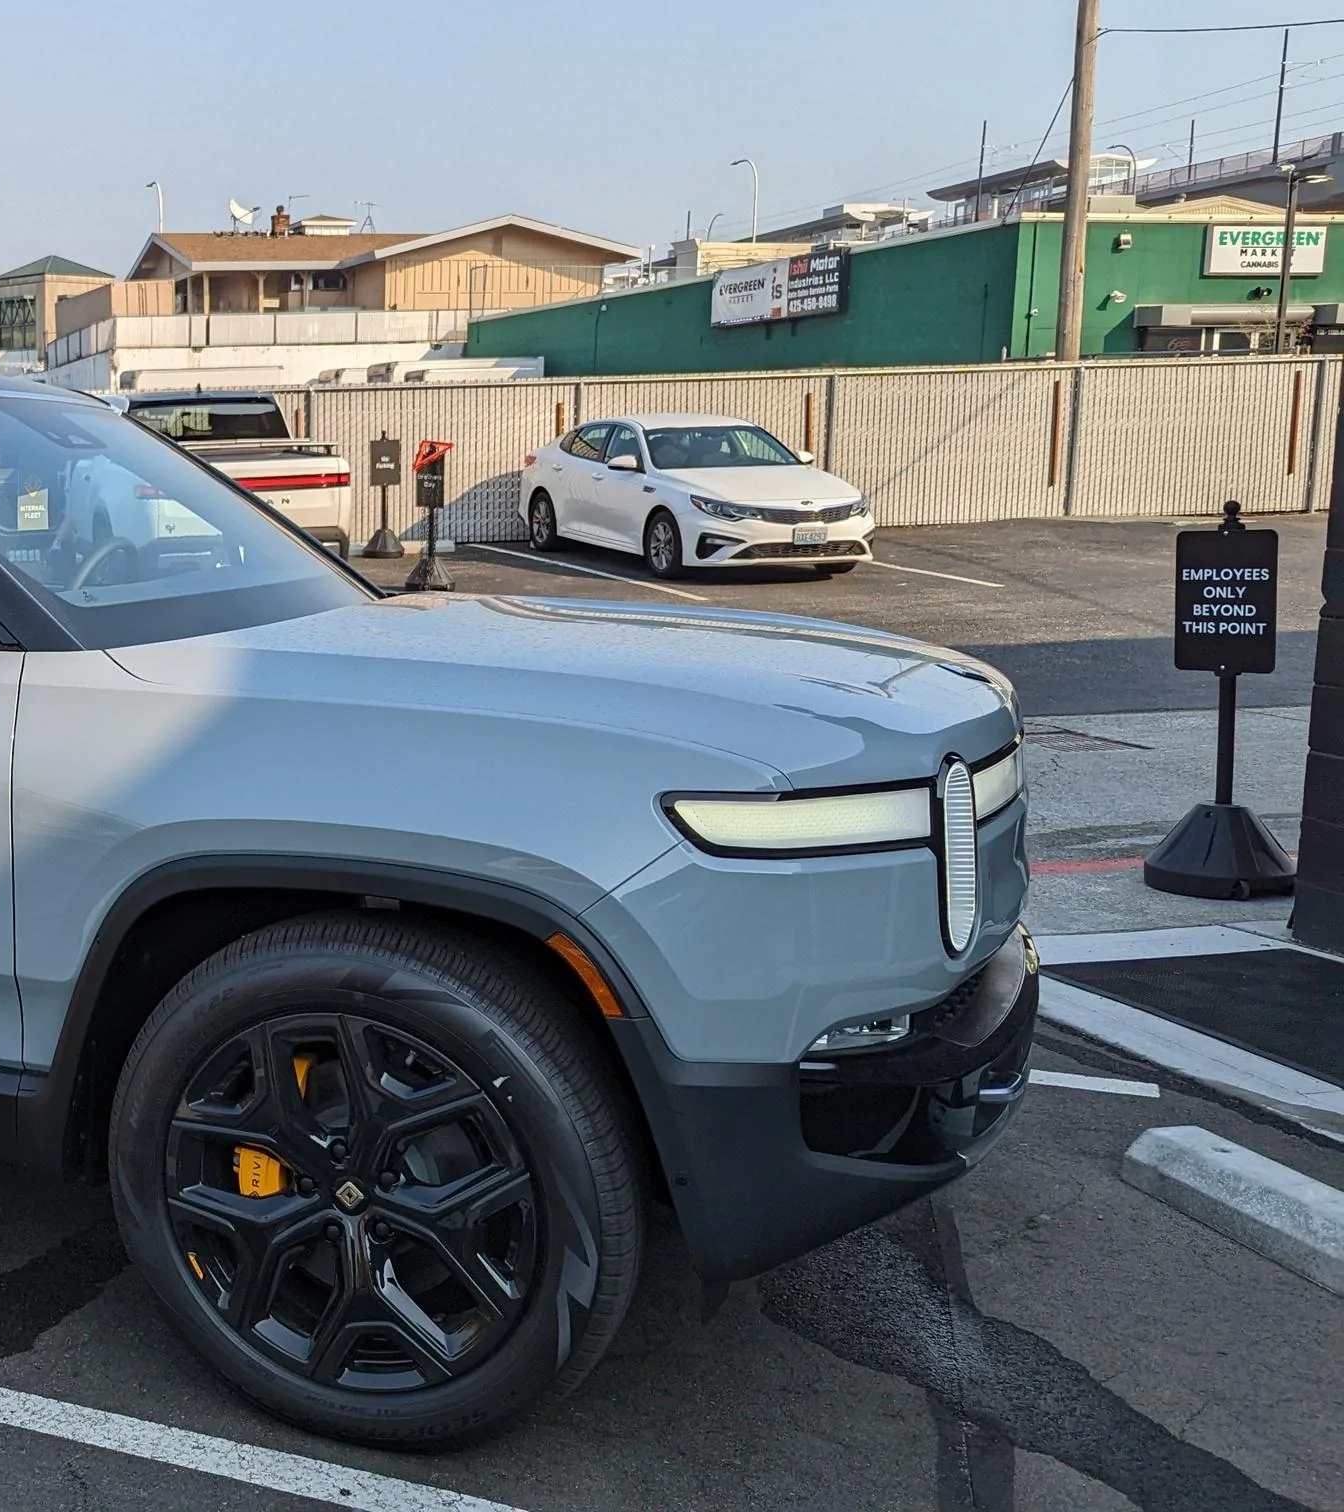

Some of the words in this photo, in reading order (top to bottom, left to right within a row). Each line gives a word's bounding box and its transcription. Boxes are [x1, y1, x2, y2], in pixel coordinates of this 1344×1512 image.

[1240, 248, 1296, 257] MARKT
[810, 255, 840, 273] Motor
[825, 271, 839, 283] LLC
[719, 279, 765, 296] EVERGREEN
[1182, 568, 1270, 581] EMPLOYEES
[1203, 586, 1246, 599] ONLY
[1193, 604, 1257, 617] BEYOND
[1182, 621, 1216, 634] THIS
[1219, 622, 1267, 635] POINT
[252, 1155, 261, 1188] RIVI
